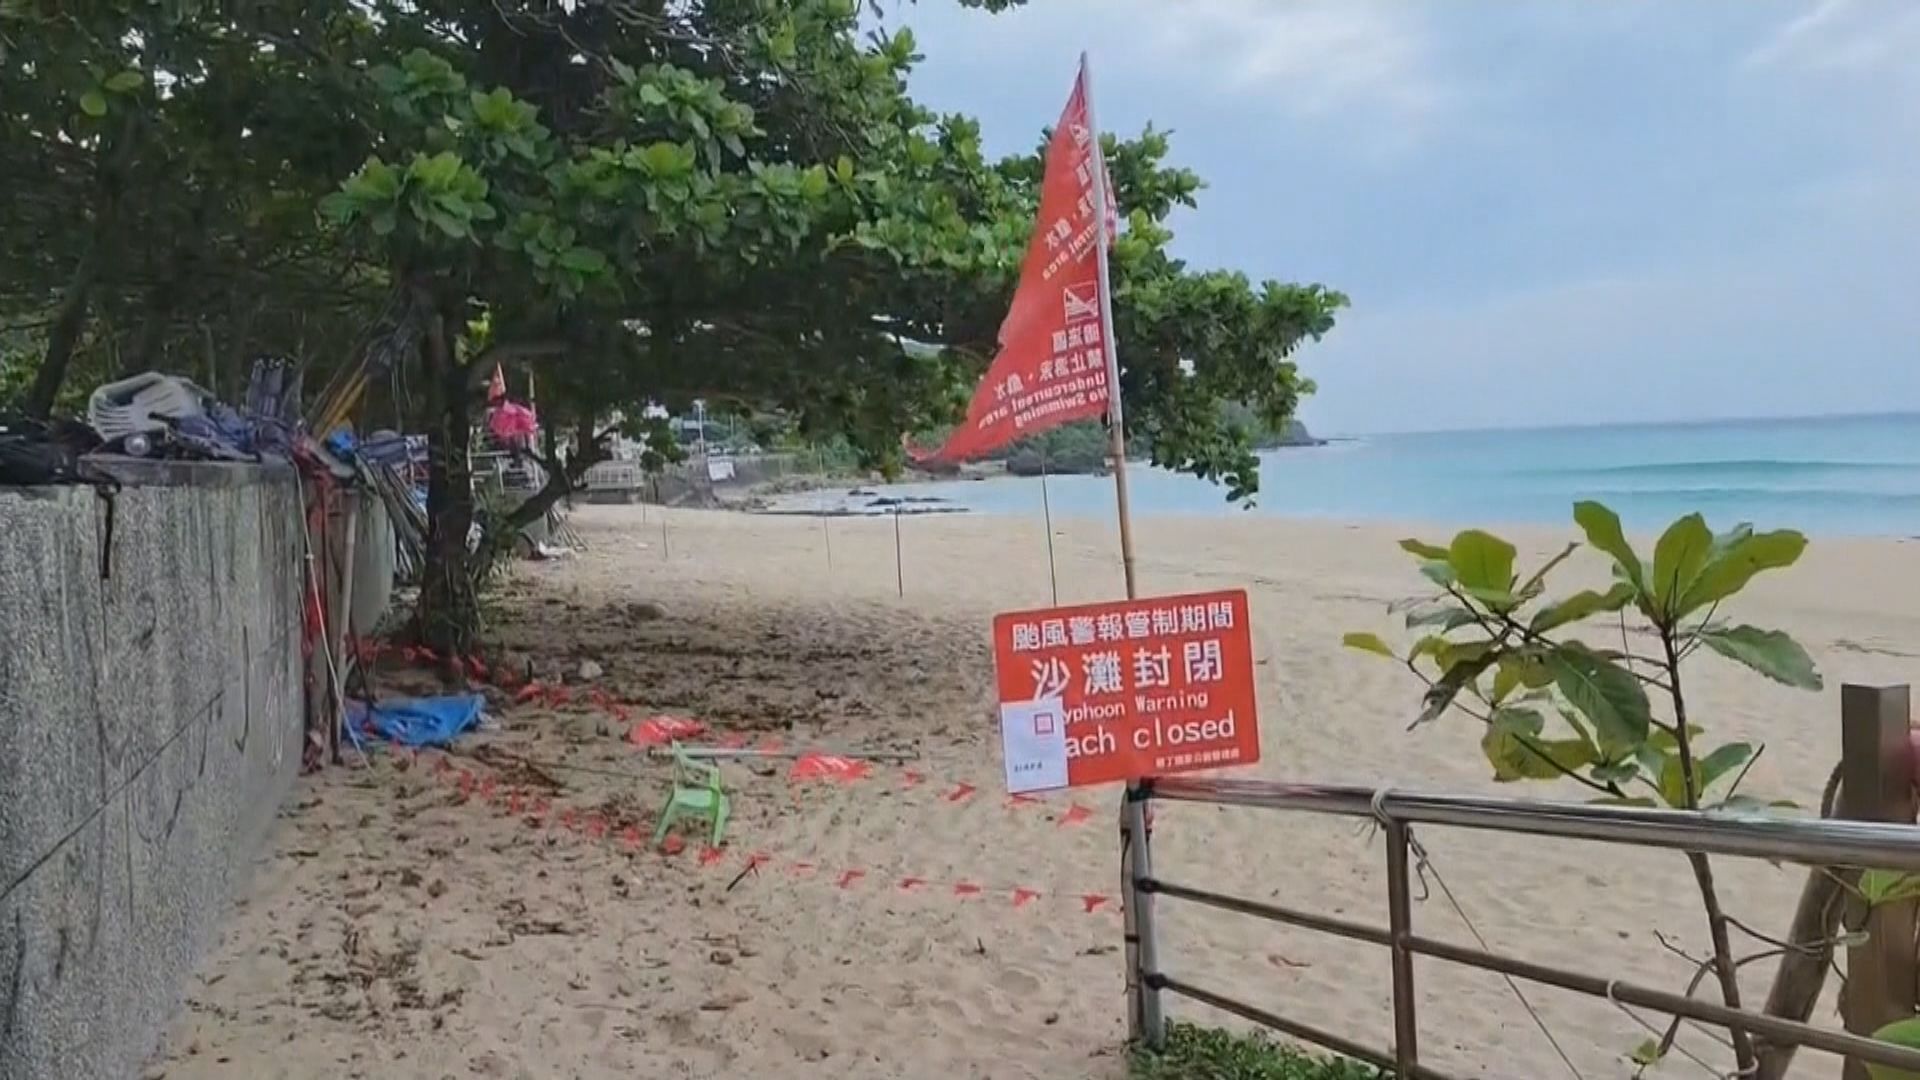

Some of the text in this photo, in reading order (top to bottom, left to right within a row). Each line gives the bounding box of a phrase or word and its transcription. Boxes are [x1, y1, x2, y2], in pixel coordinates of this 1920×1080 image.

[1012, 601, 1233, 652] 颱風警報管制期間
[1031, 640, 1223, 701] 沙灘封閉
[1063, 690, 1208, 726] yphoon Warning
[1066, 726, 1116, 759] ach
[1133, 709, 1235, 749] closed
